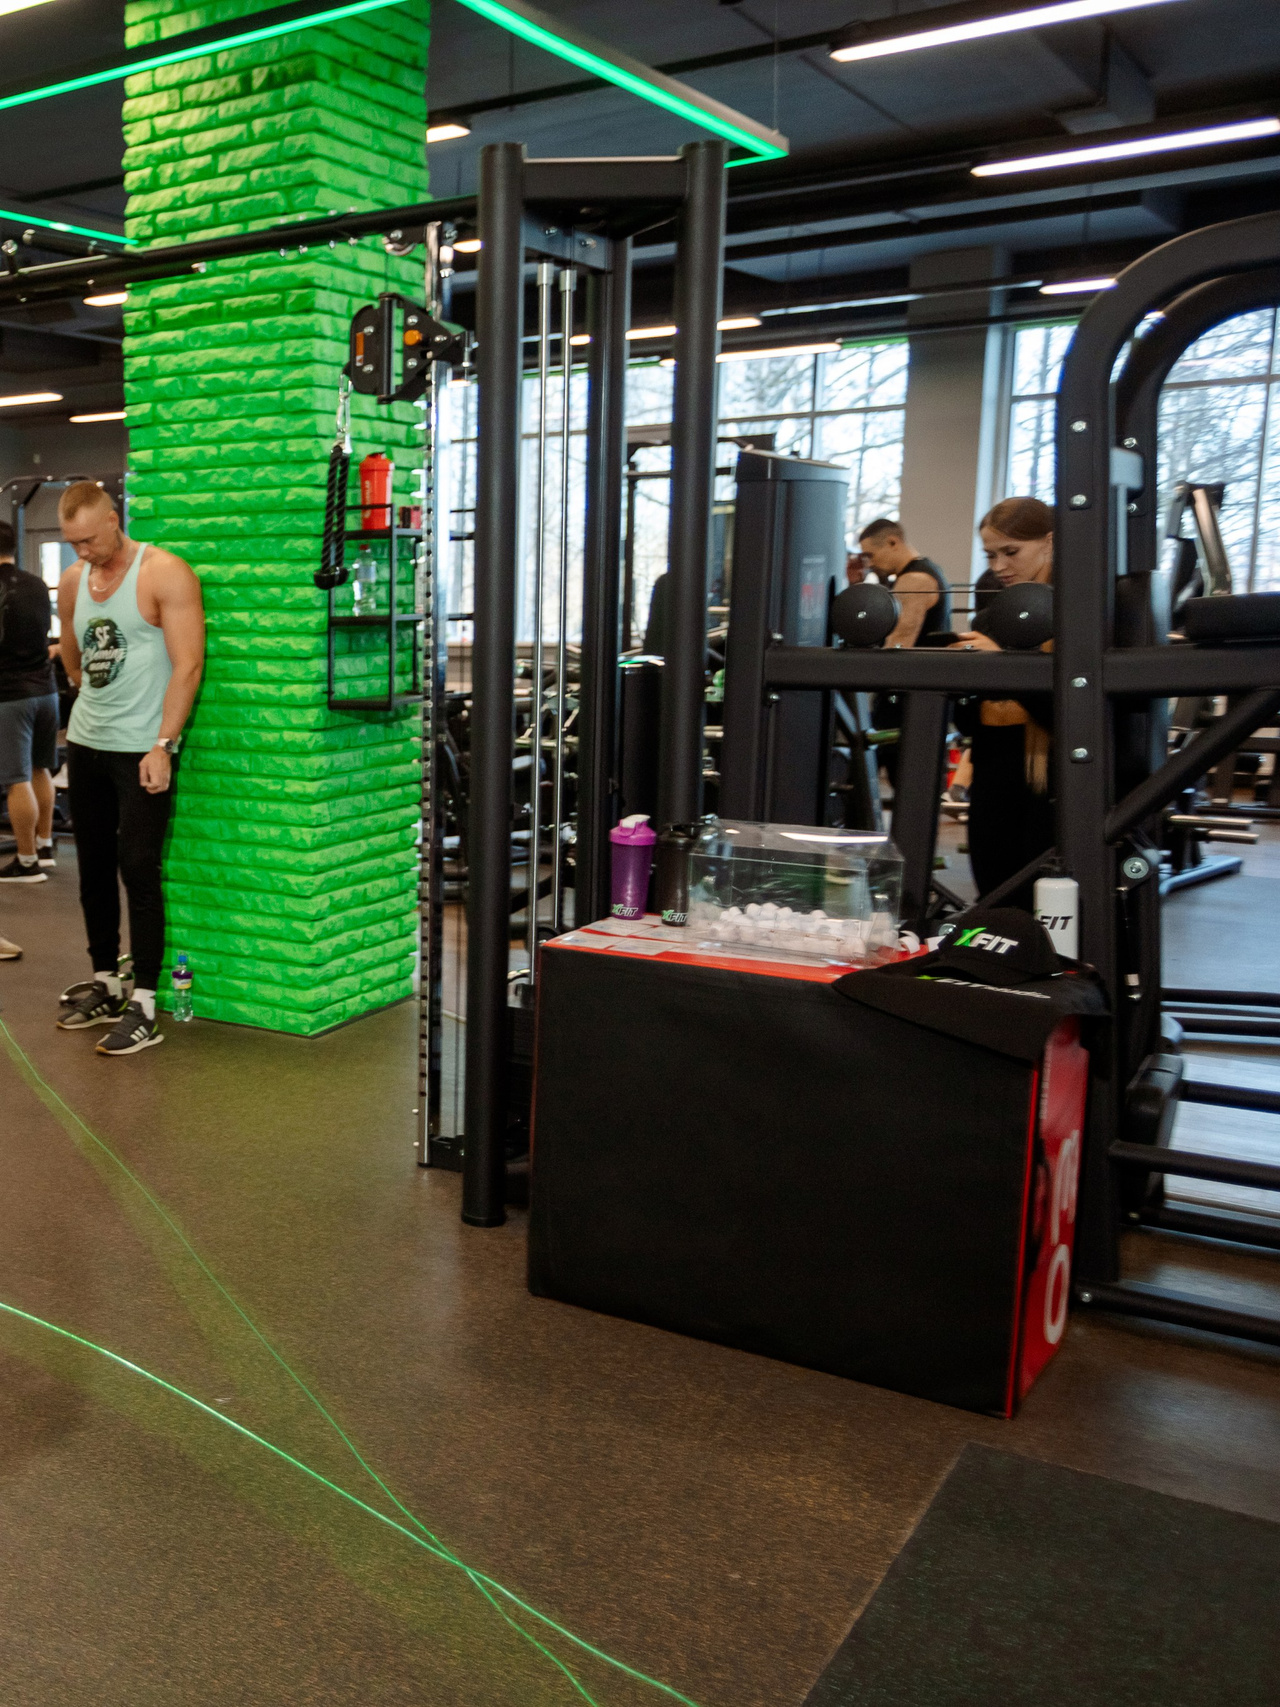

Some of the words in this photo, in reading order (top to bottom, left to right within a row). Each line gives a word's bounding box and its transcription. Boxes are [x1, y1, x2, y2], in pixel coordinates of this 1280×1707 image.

[612, 903, 639, 917] XFIT
[661, 909, 688, 922] XFIT
[1034, 908, 1074, 931] FIT
[953, 926, 1019, 954] XFIT
